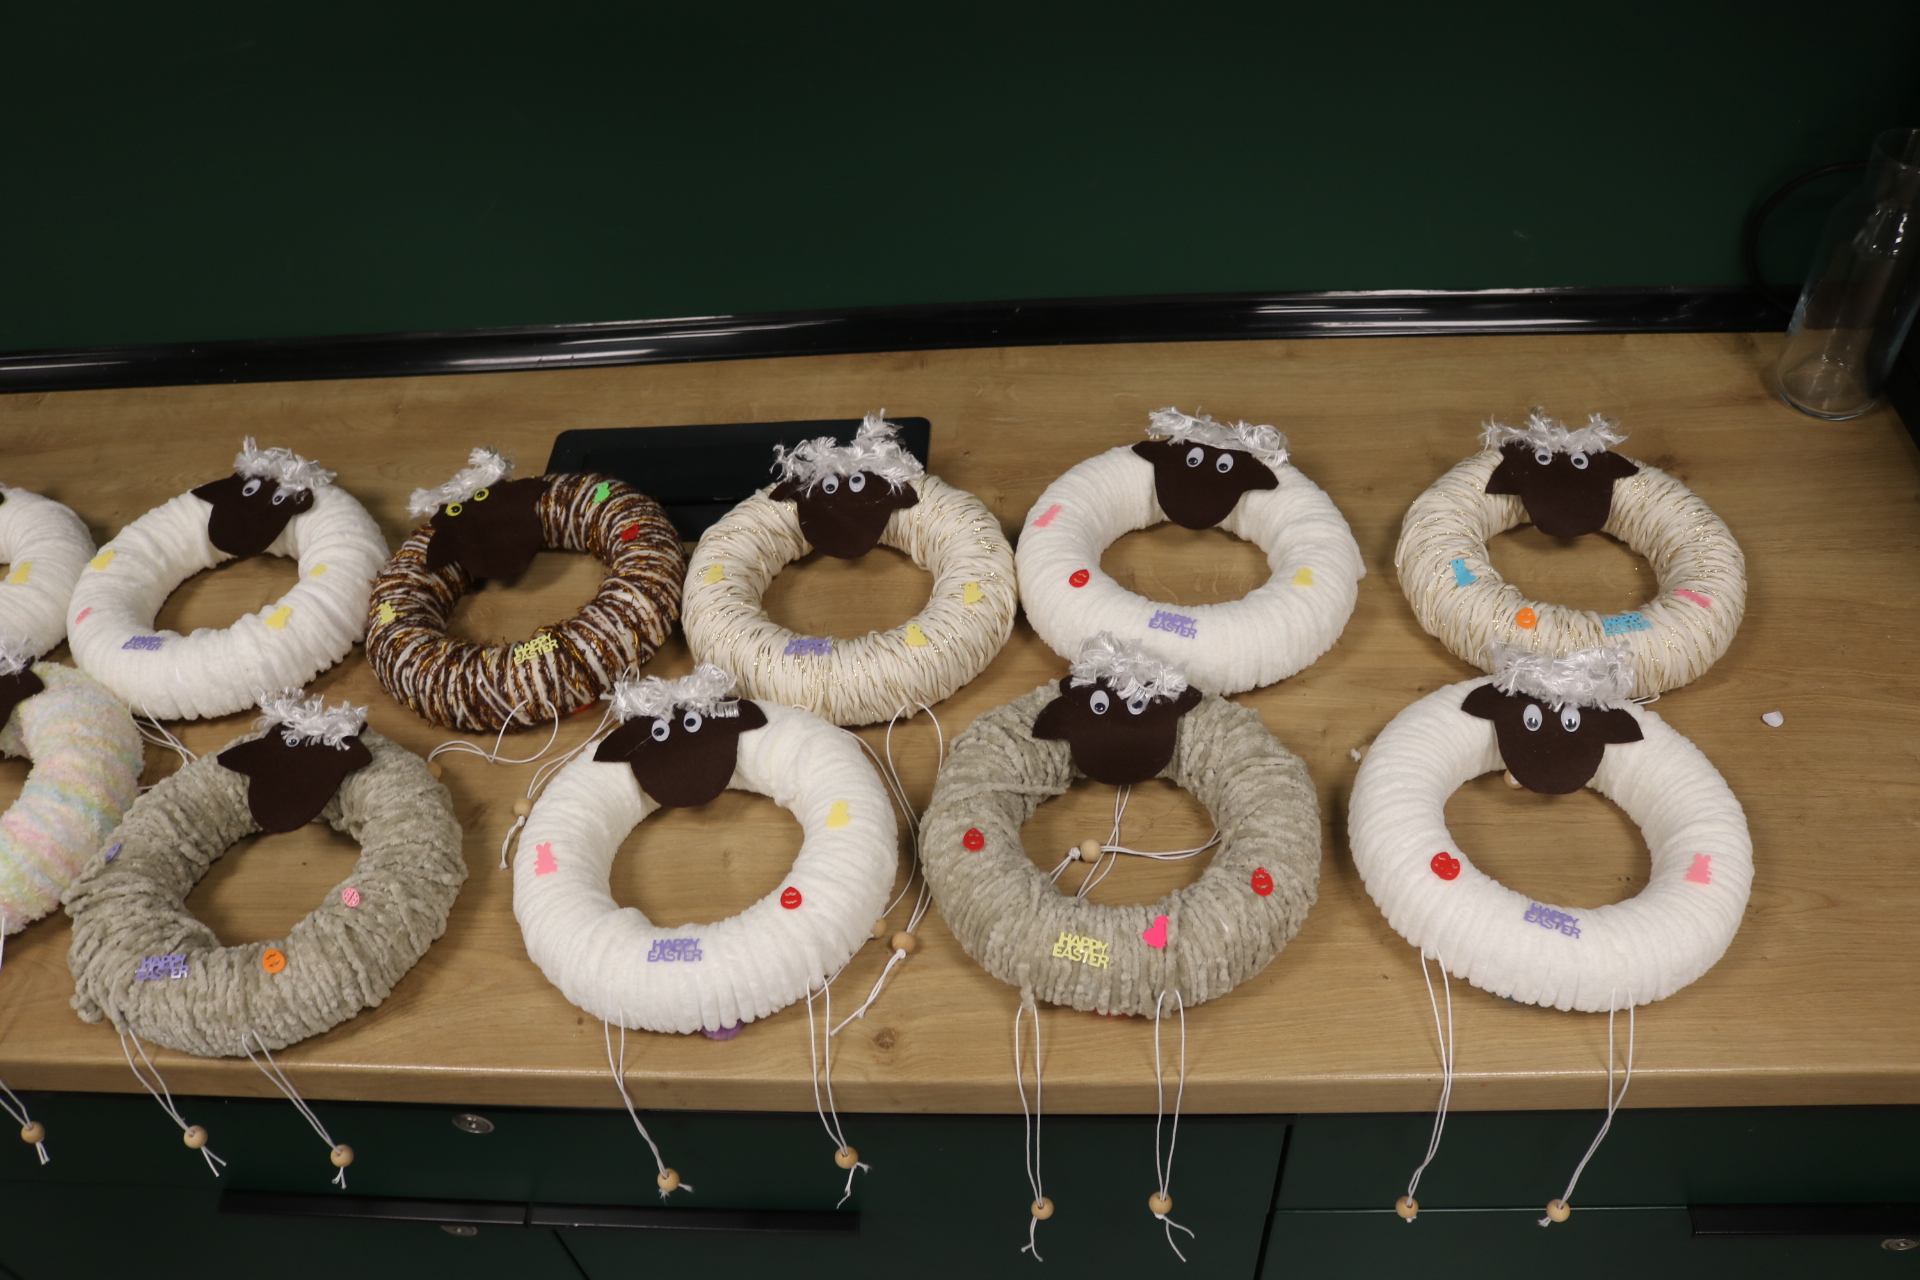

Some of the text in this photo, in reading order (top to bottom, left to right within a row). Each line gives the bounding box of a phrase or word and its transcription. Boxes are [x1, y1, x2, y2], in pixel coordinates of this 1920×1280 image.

[1155, 610, 1197, 625] HAPPY
[513, 639, 559, 665] EASTER
[514, 632, 551, 653] HAPPY
[1523, 910, 1581, 939] EASTER
[1530, 903, 1579, 925] HAPPY
[652, 938, 700, 951] HAPPY
[1058, 932, 1108, 953] HAPPY
[141, 954, 188, 968] HAPPY
[647, 949, 703, 962] EASTER
[1052, 942, 1109, 969] EASTER
[135, 965, 190, 980] EASTER
